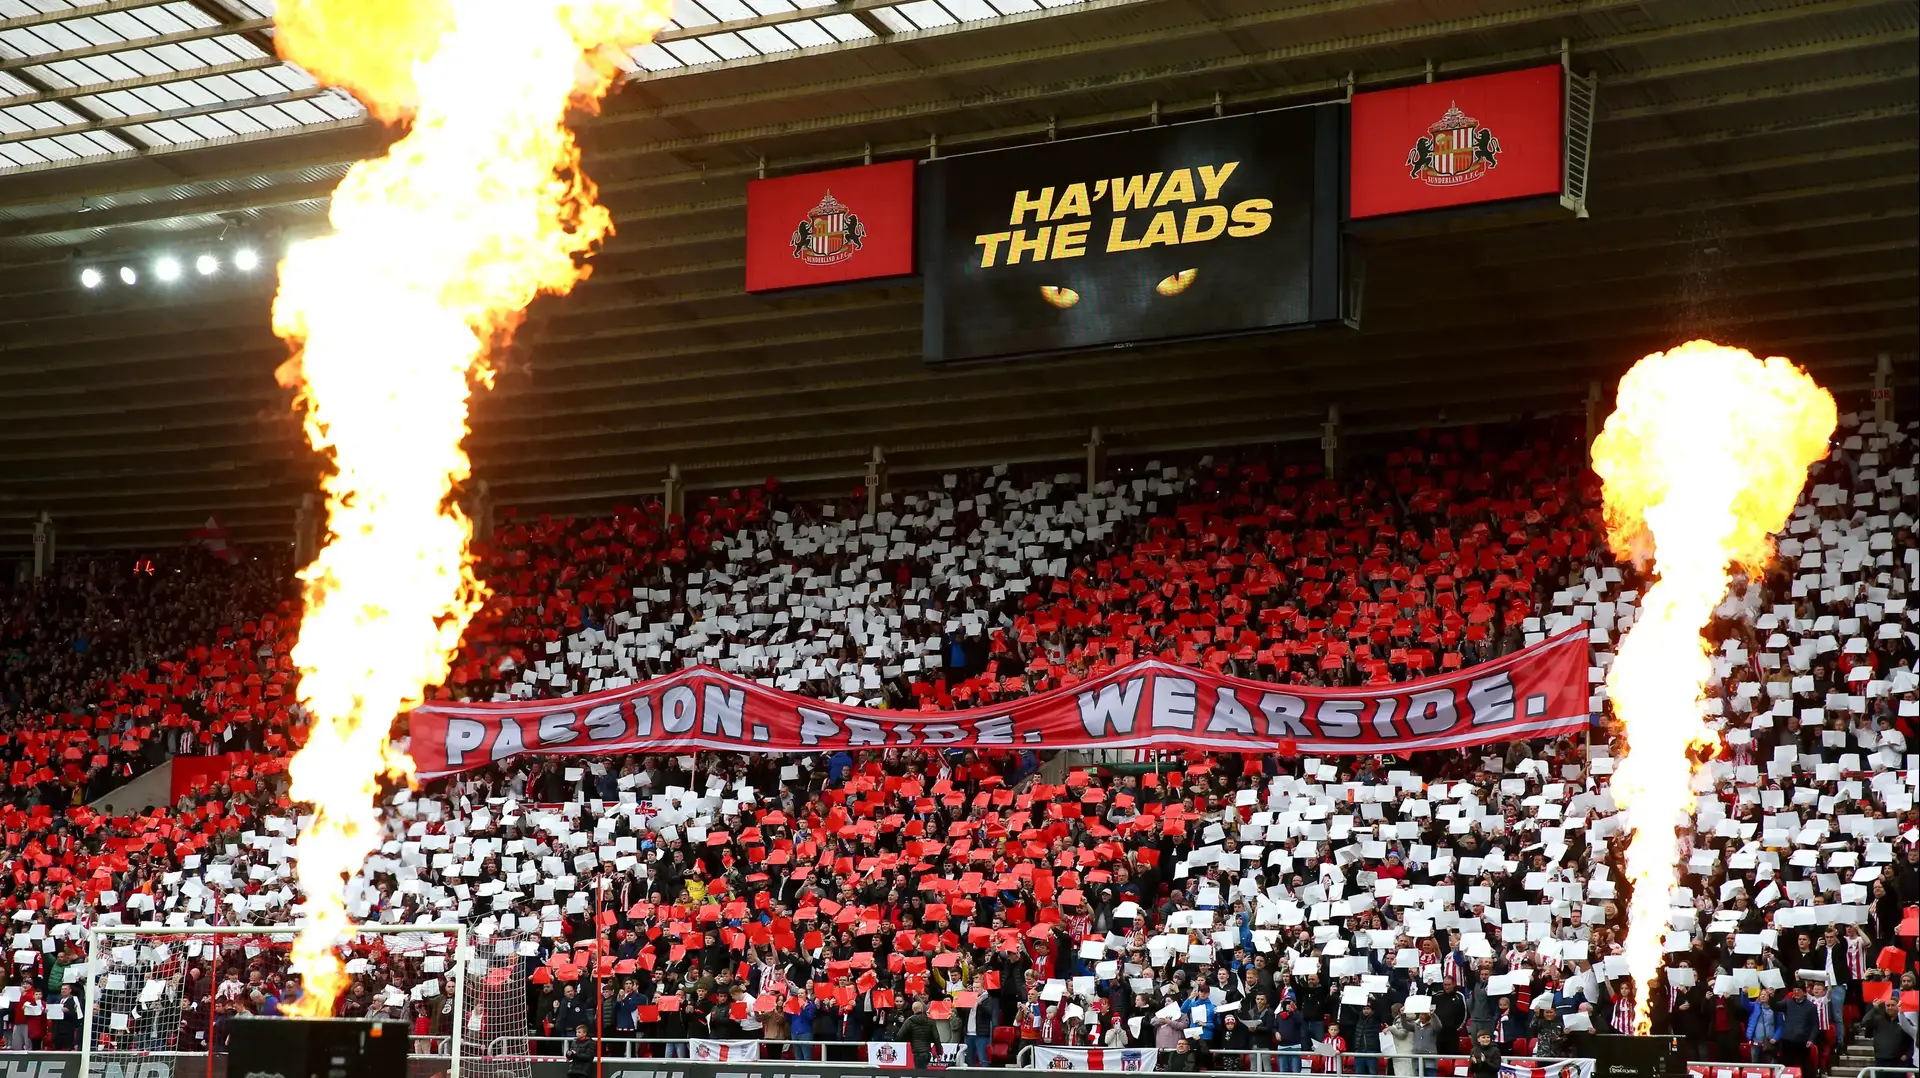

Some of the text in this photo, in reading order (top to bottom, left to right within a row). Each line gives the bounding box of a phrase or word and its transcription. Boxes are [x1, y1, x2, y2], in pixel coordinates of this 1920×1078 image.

[1009, 161, 1240, 226] HA'WAY
[1427, 176, 1463, 184] SUNDERLAND
[975, 198, 1274, 269] THE LADS
[446, 671, 1547, 766] PASSION. PRIDE. WEARSIDE.
